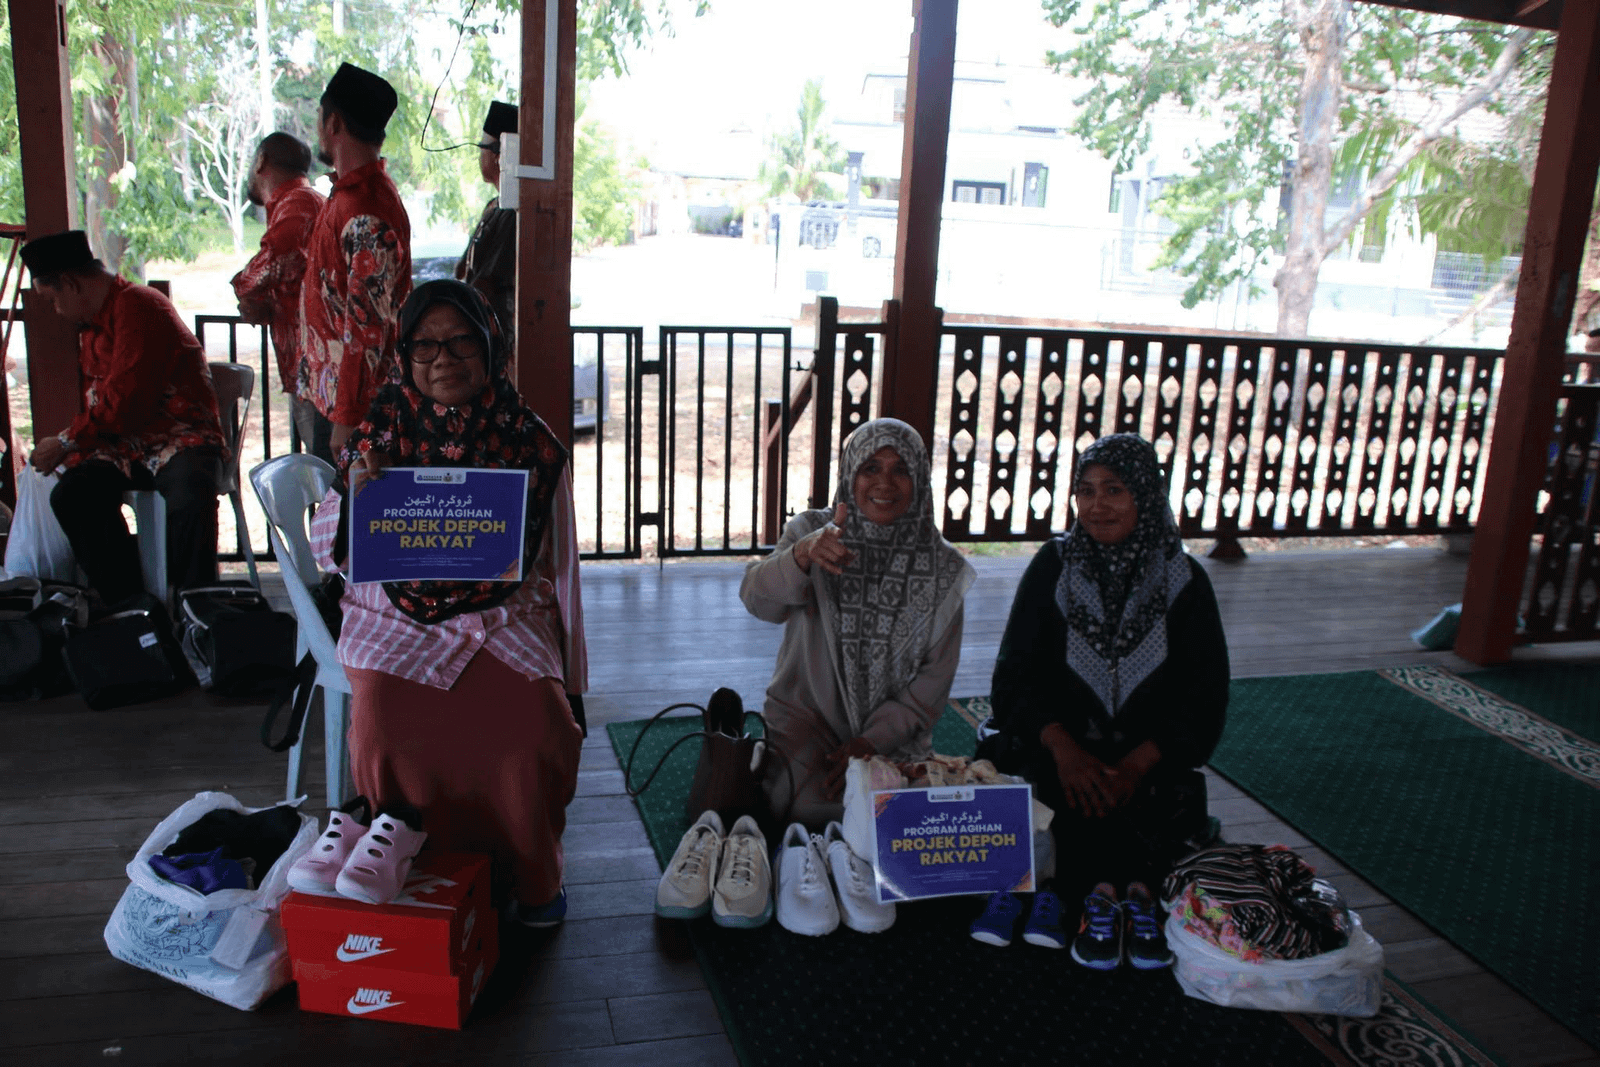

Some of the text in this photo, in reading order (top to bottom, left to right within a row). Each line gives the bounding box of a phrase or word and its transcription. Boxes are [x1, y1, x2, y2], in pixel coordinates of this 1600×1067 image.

[383, 508, 493, 518] PROGRAM AGIHAN
[369, 519, 506, 534] PROJEK DEPOH
[400, 535, 476, 549] RAKYAT
[903, 823, 1002, 837] PROGRAM AGIHAN
[891, 833, 1017, 853] PROJEK DEPOH
[919, 849, 989, 866] RAKYAT
[344, 934, 384, 952] NIKE
[354, 988, 393, 1005] NIKE
